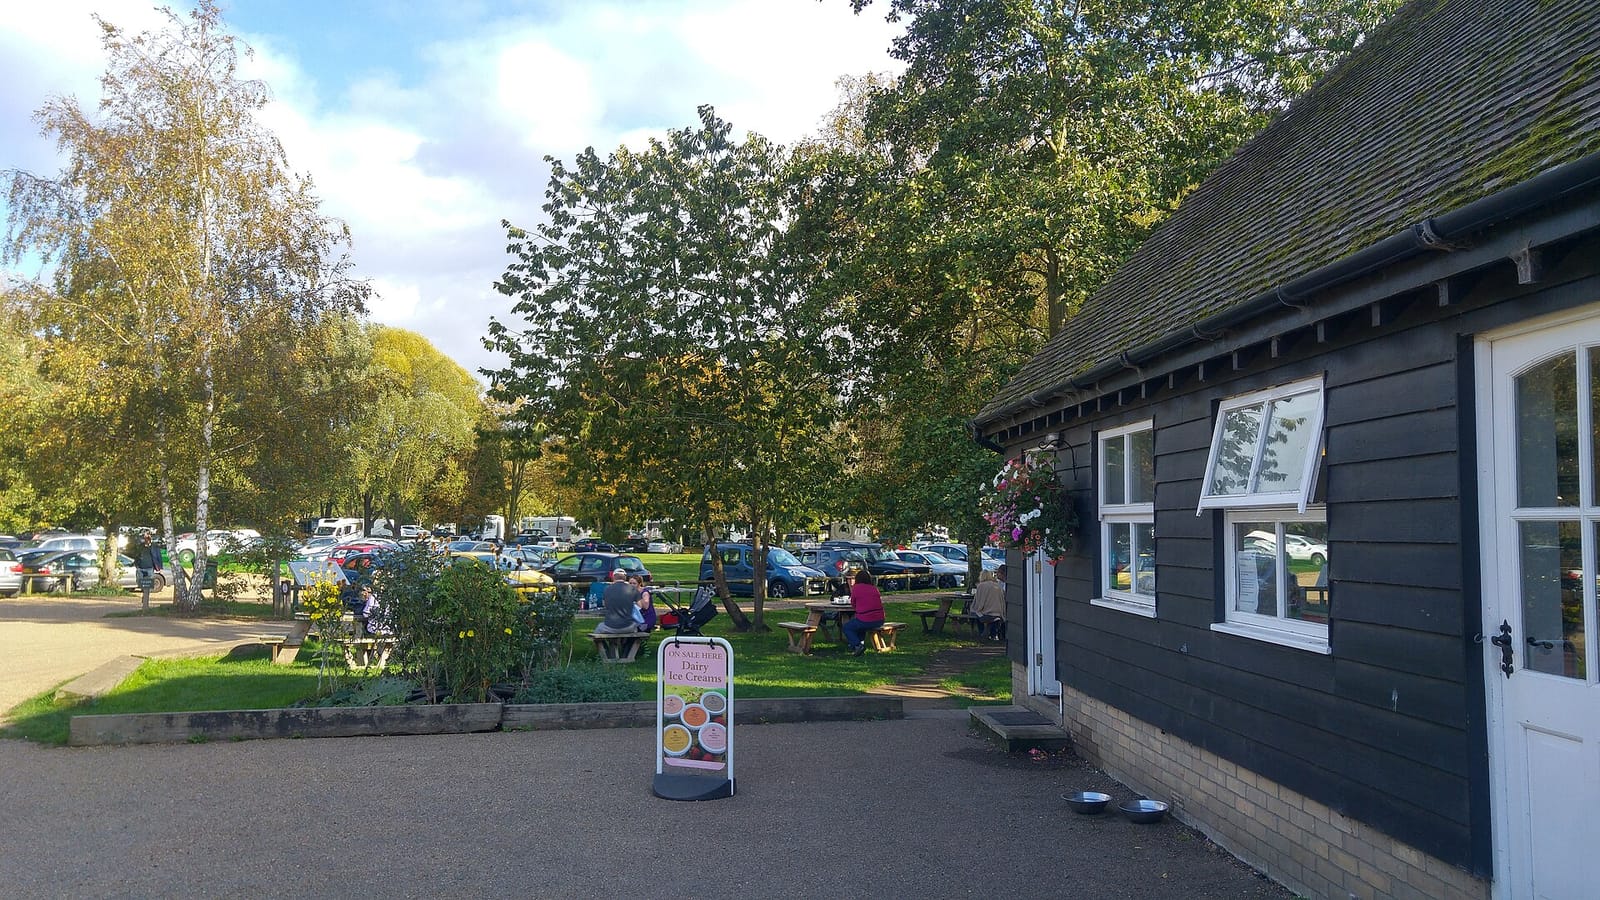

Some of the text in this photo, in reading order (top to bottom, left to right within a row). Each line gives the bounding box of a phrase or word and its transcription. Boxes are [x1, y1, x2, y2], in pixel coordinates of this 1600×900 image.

[702, 652, 722, 660] HERE
[682, 661, 709, 673] Dairy
[669, 671, 722, 683] Ice Creams
